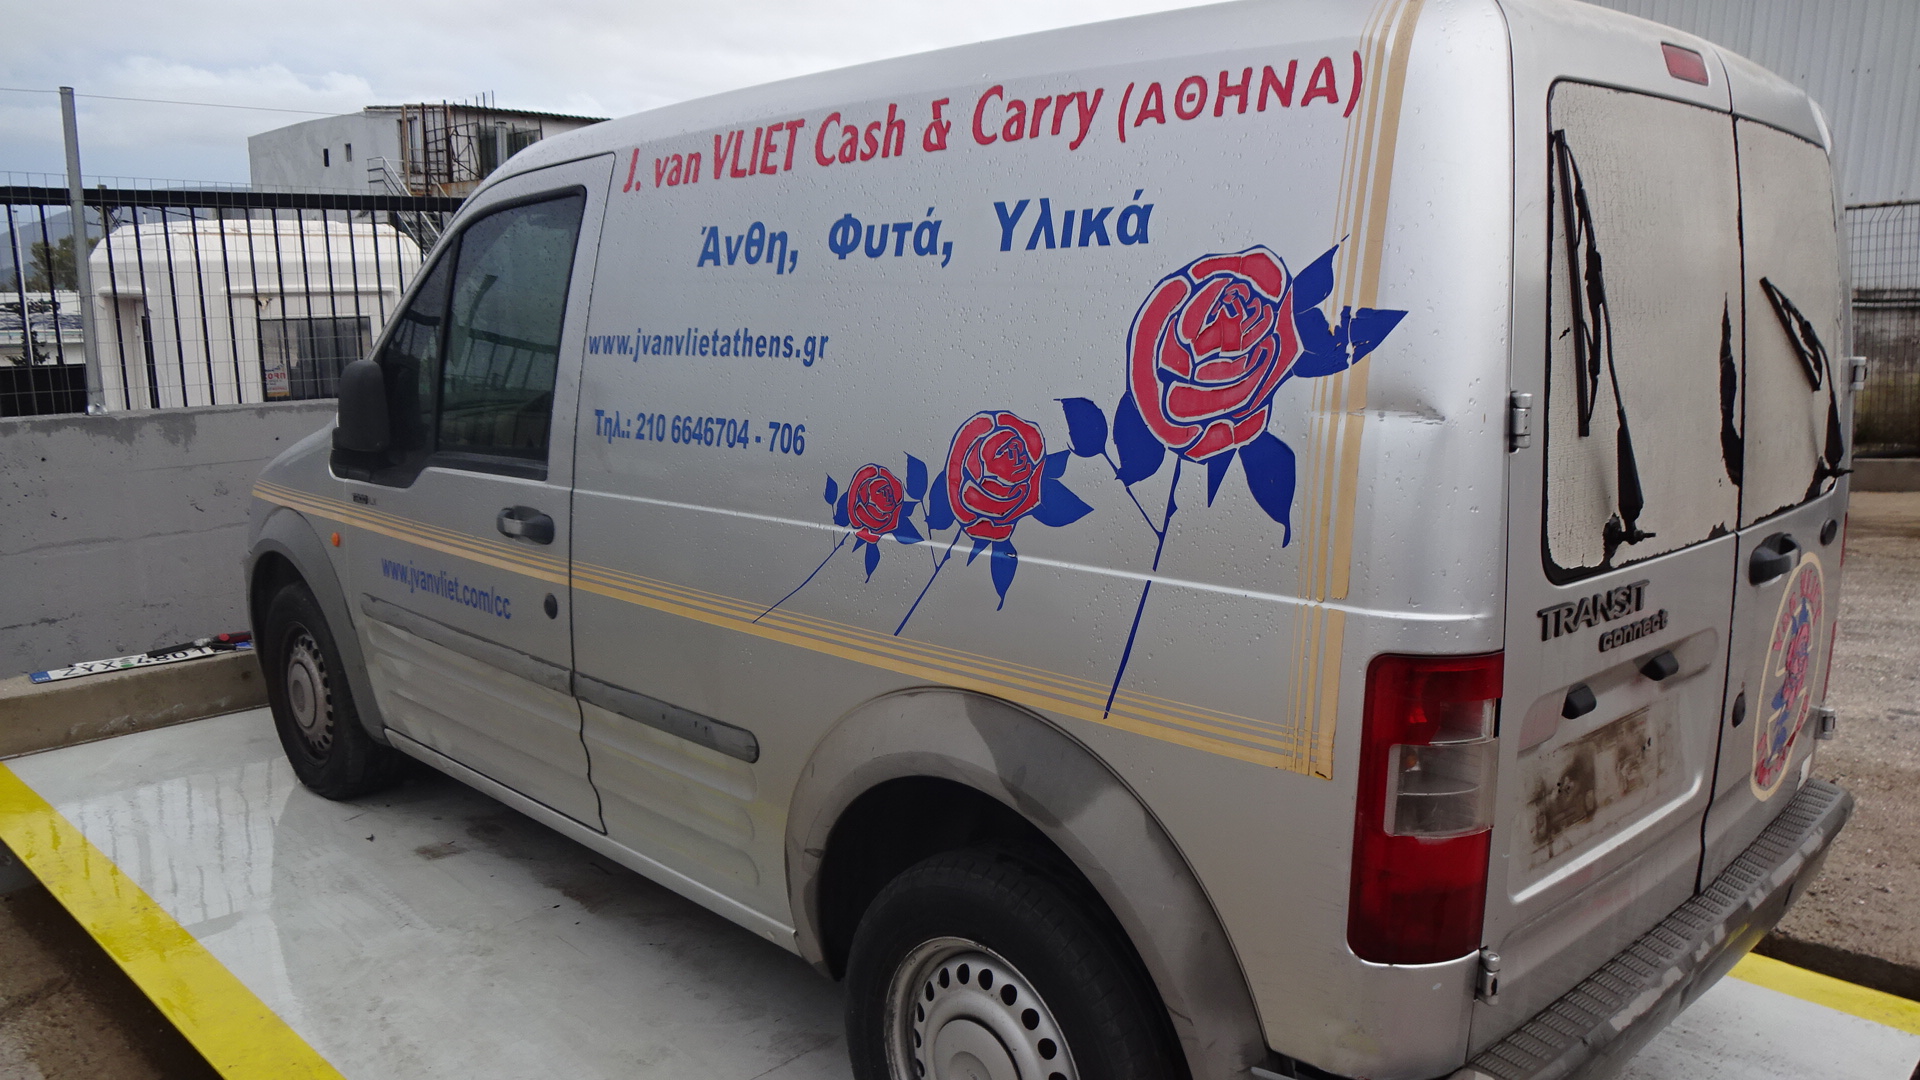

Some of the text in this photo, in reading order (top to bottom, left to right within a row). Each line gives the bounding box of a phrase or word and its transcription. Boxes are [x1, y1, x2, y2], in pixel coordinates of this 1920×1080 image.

[623, 50, 1363, 193] J. van VLIET Cash & Carry (ΑΘΗΝΑ)
[697, 188, 1155, 275] Άνθη, Φυτά, Υλικά
[588, 327, 830, 367] www.jvanvlietathens.gr
[594, 408, 806, 456] Τηλ.: 210 6646704 - 706
[381, 558, 512, 620] www.jvanvliet.com/cc
[1537, 579, 1669, 652] TRANSIT connect
